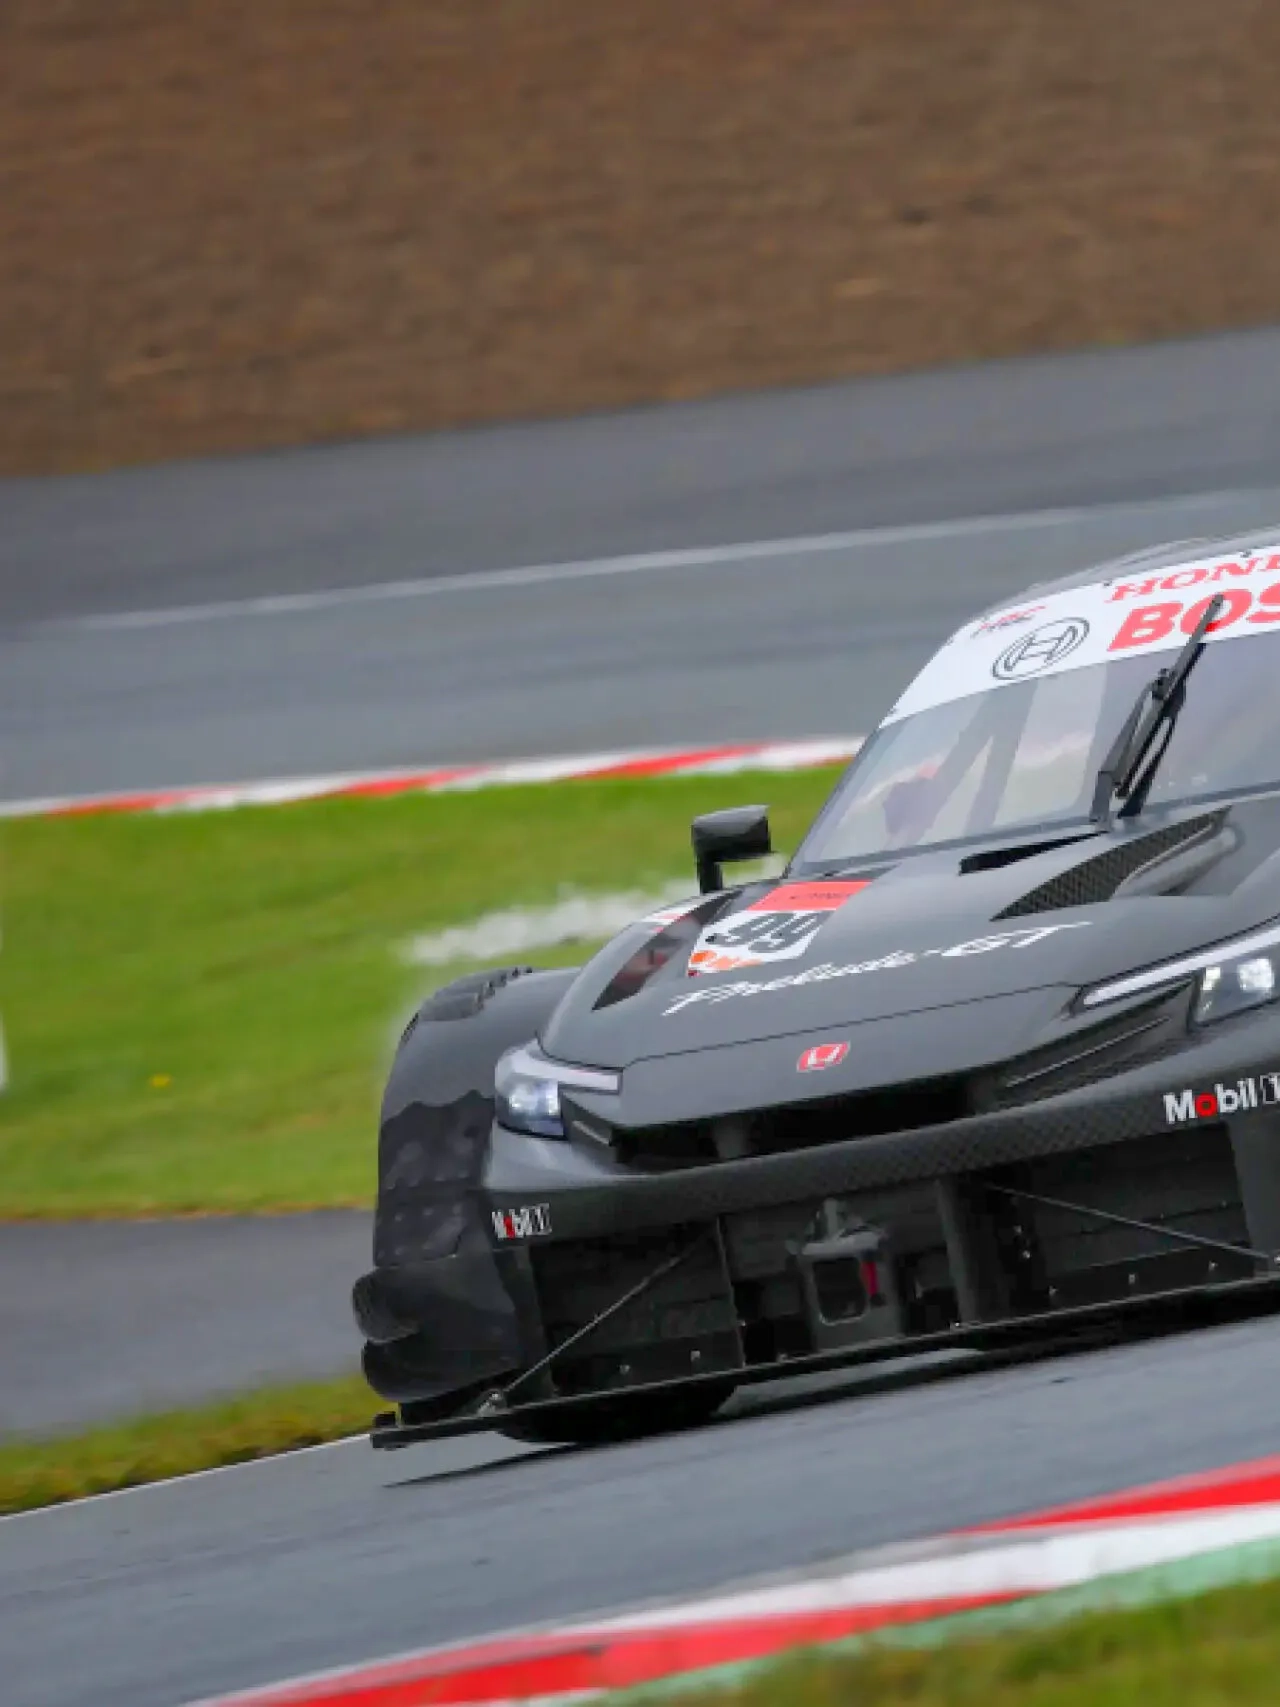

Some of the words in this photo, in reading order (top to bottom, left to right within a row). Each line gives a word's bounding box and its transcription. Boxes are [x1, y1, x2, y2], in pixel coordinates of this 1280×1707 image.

[705, 911, 834, 954] 99
[661, 920, 1094, 1016] Prelude-GT
[1163, 1077, 1258, 1125] Mobil
